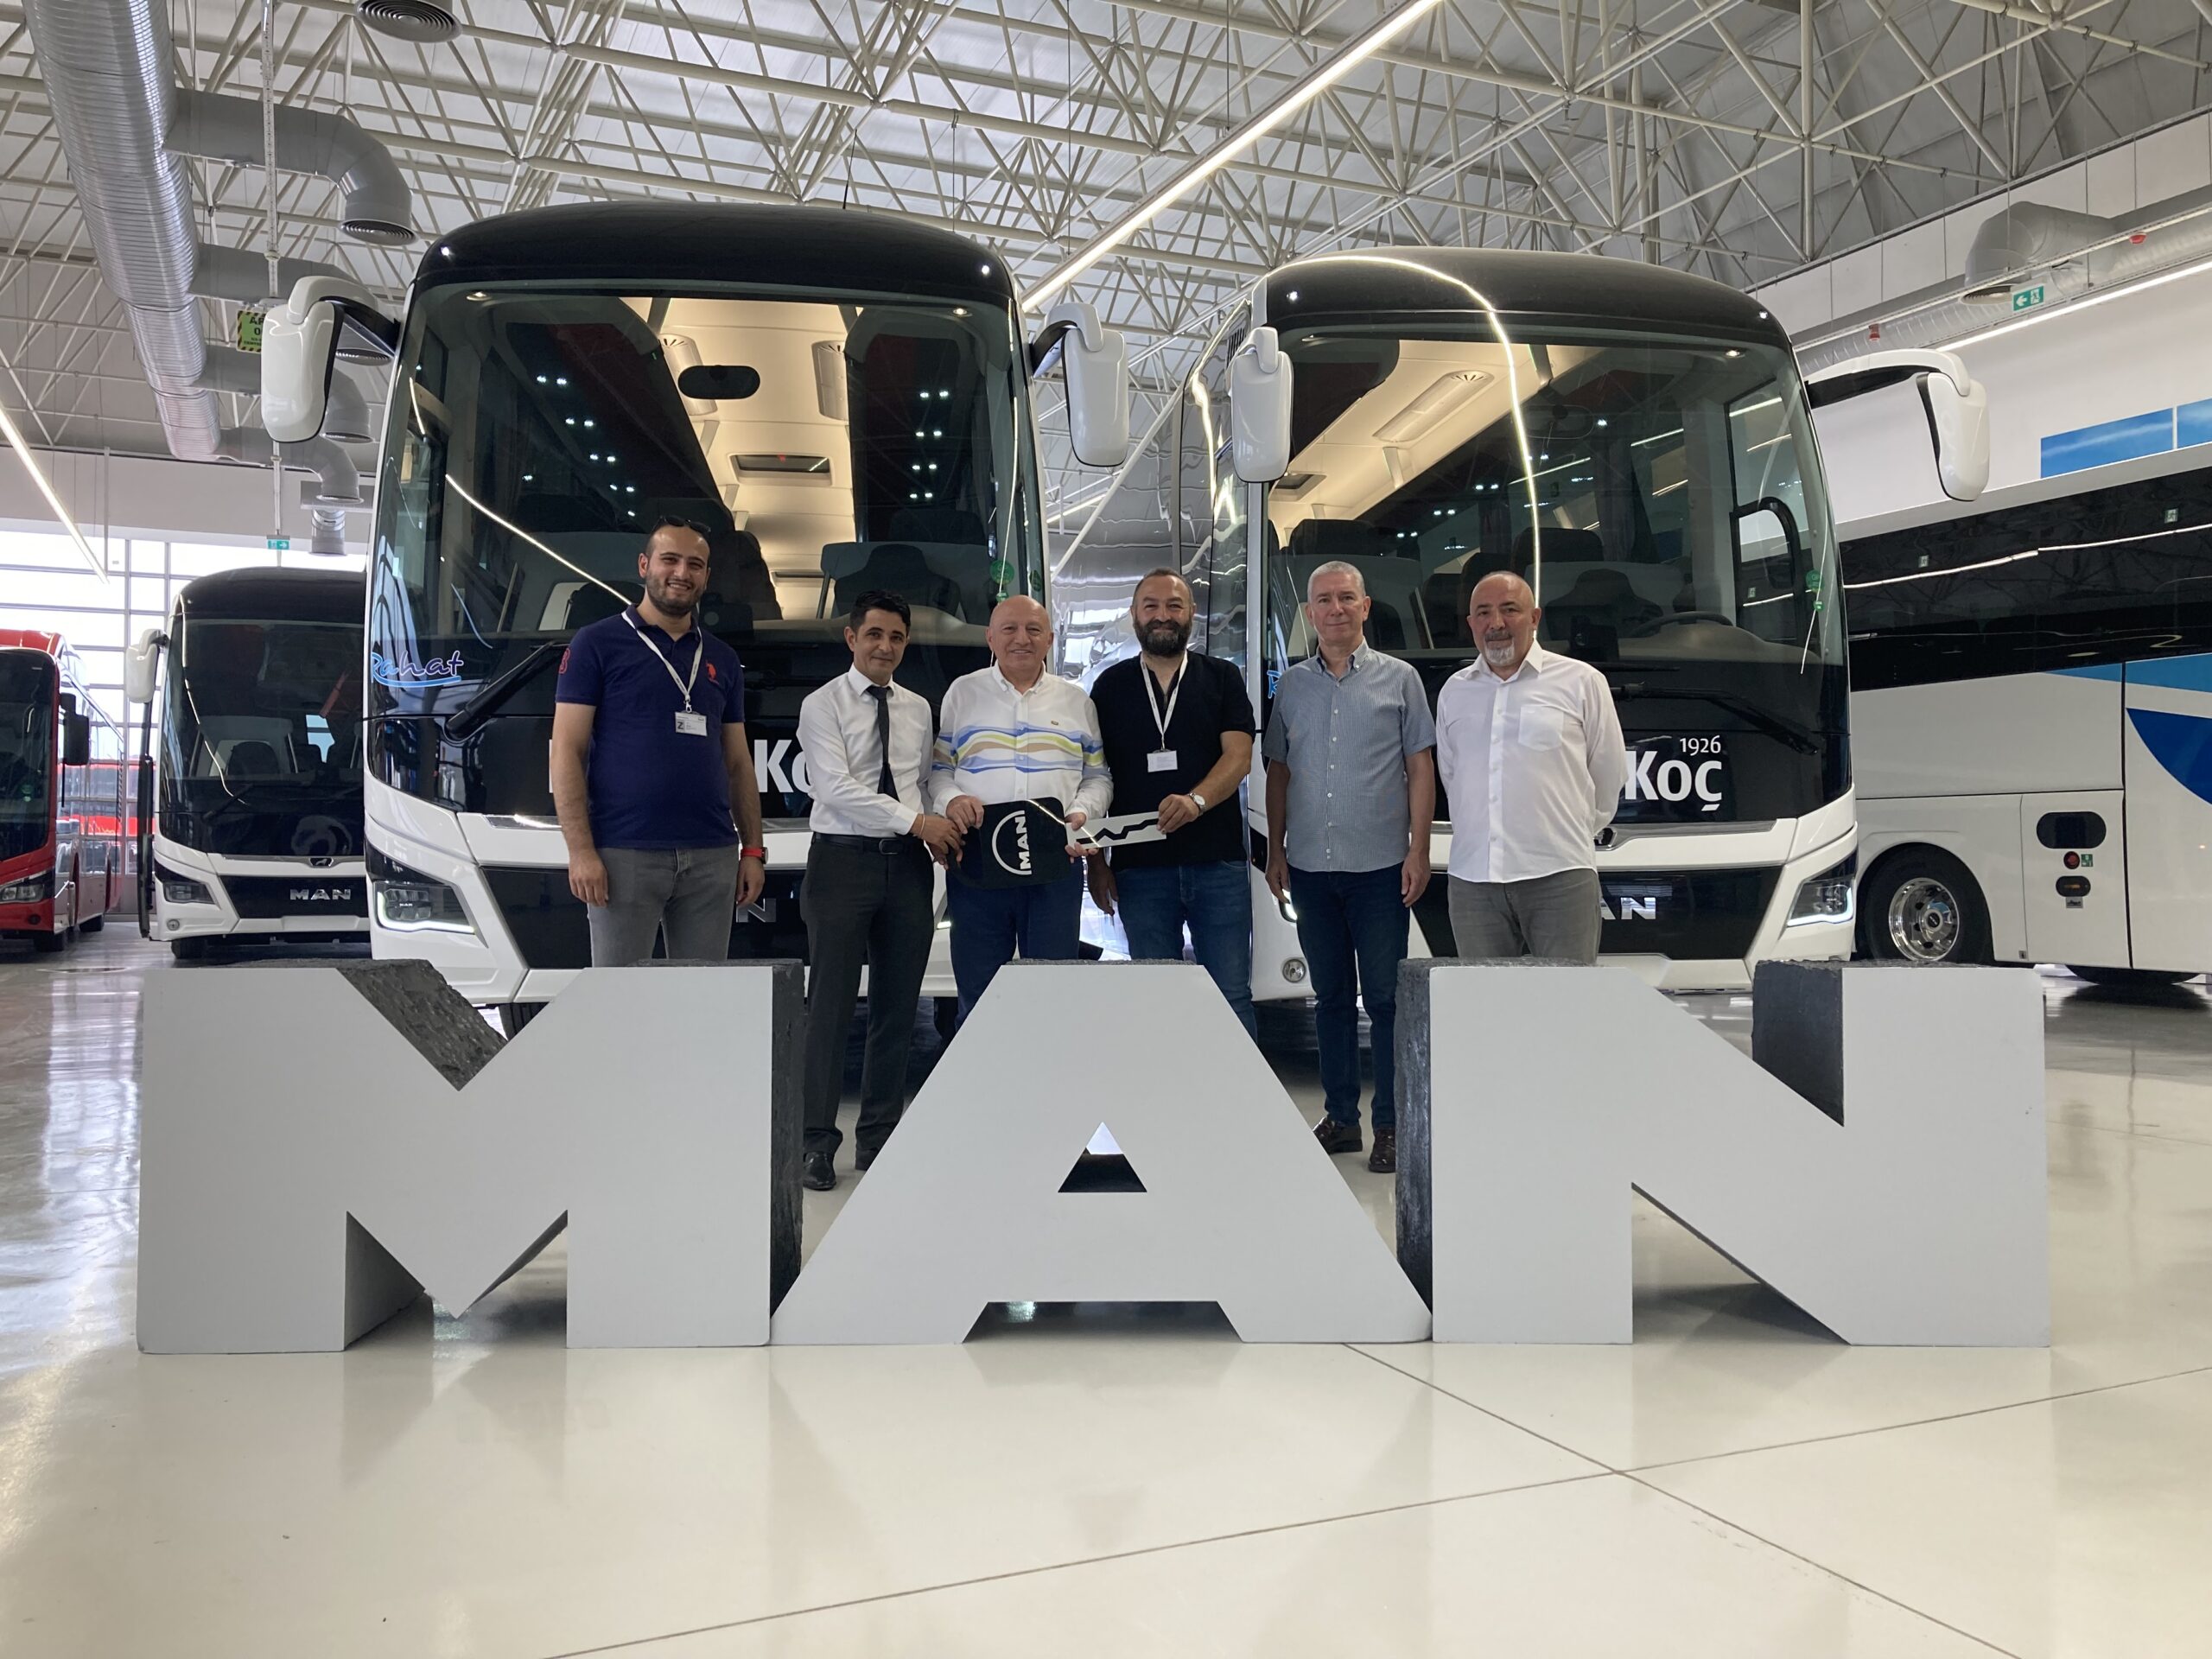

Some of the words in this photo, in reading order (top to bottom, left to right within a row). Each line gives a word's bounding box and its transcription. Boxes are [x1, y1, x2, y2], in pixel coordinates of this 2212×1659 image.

[1679, 734, 1721, 756] 1926
[1624, 750, 1722, 811] Koç
[1014, 816, 1032, 870] MAN
[289, 888, 351, 900] MAN
[137, 965, 2050, 1354] MAN
